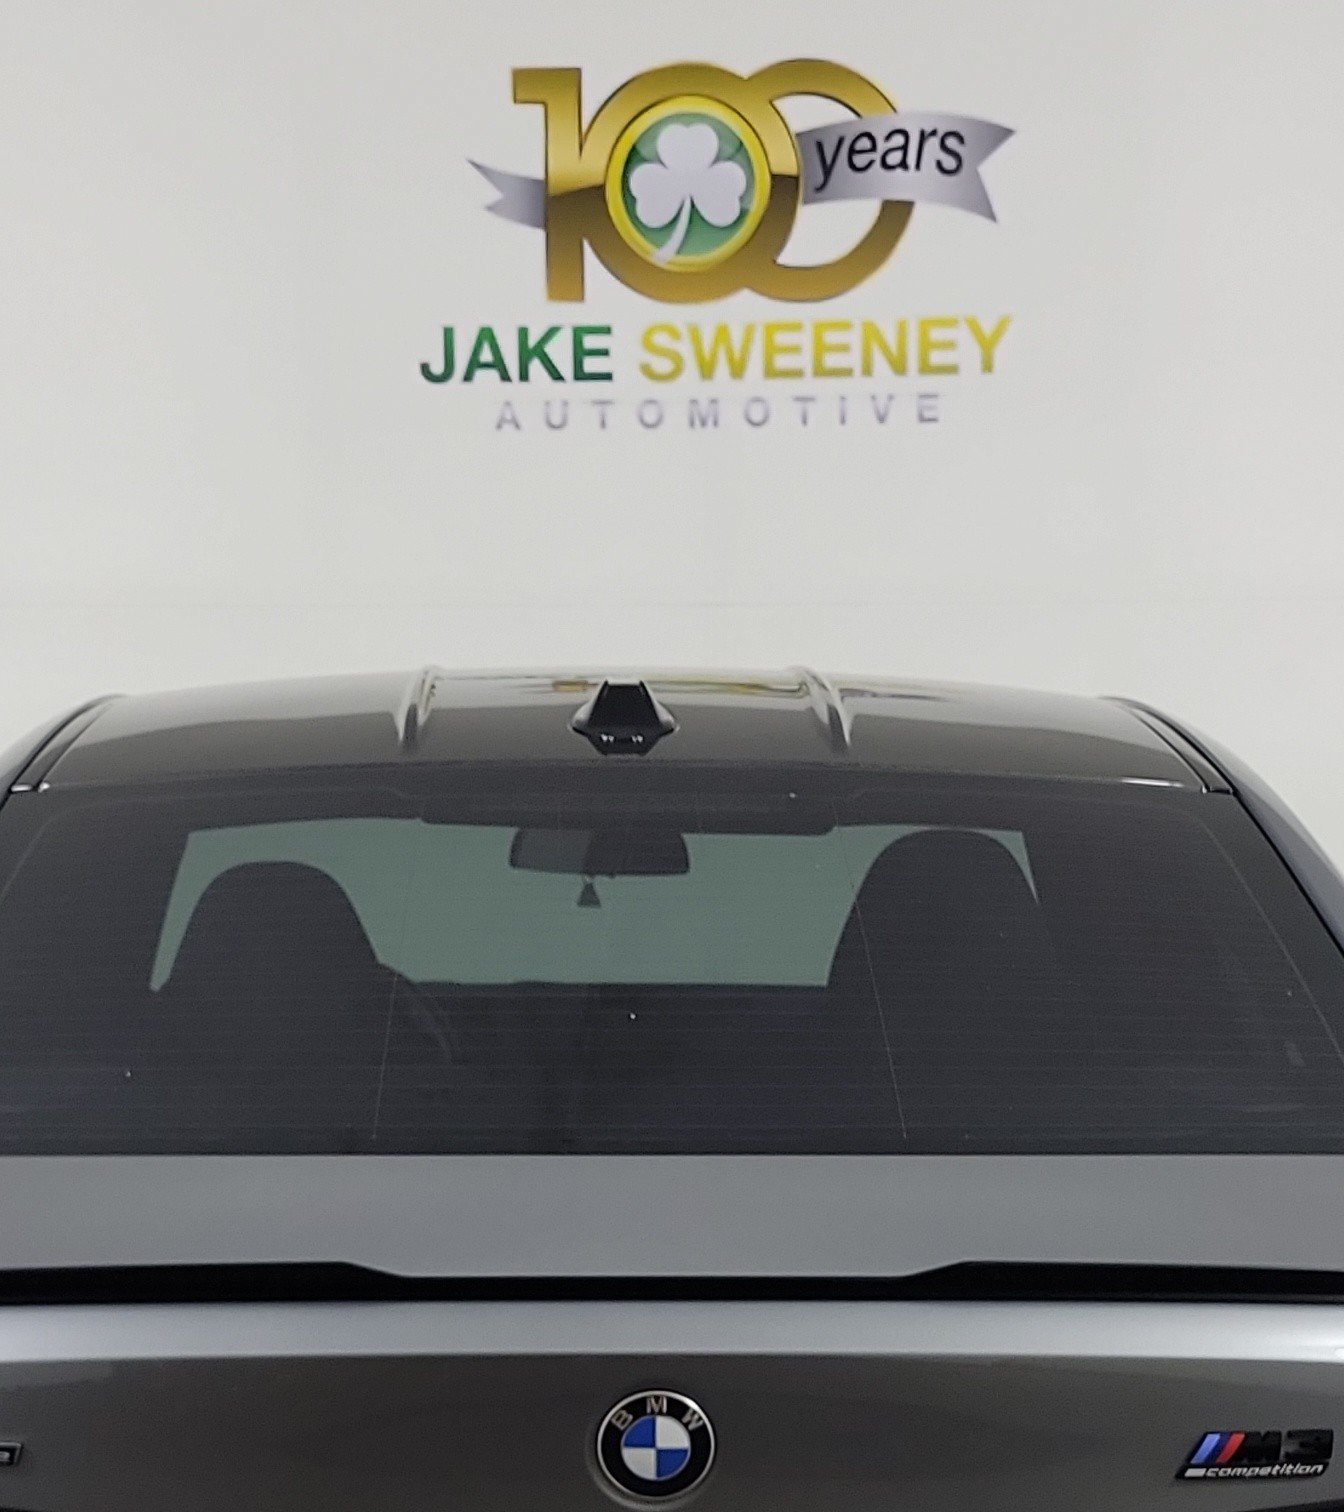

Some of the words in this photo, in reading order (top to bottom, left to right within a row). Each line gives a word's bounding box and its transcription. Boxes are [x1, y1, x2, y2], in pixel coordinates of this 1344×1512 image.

[511, 58, 915, 305] 100
[814, 126, 966, 192] years
[419, 325, 613, 384] JAKE
[638, 316, 1013, 384] SWEENEY
[494, 394, 942, 431] AUTOMOTIVE
[610, 1396, 704, 1431] BMW
[1239, 1429, 1334, 1462] M3
[1207, 1463, 1324, 1478] competition
